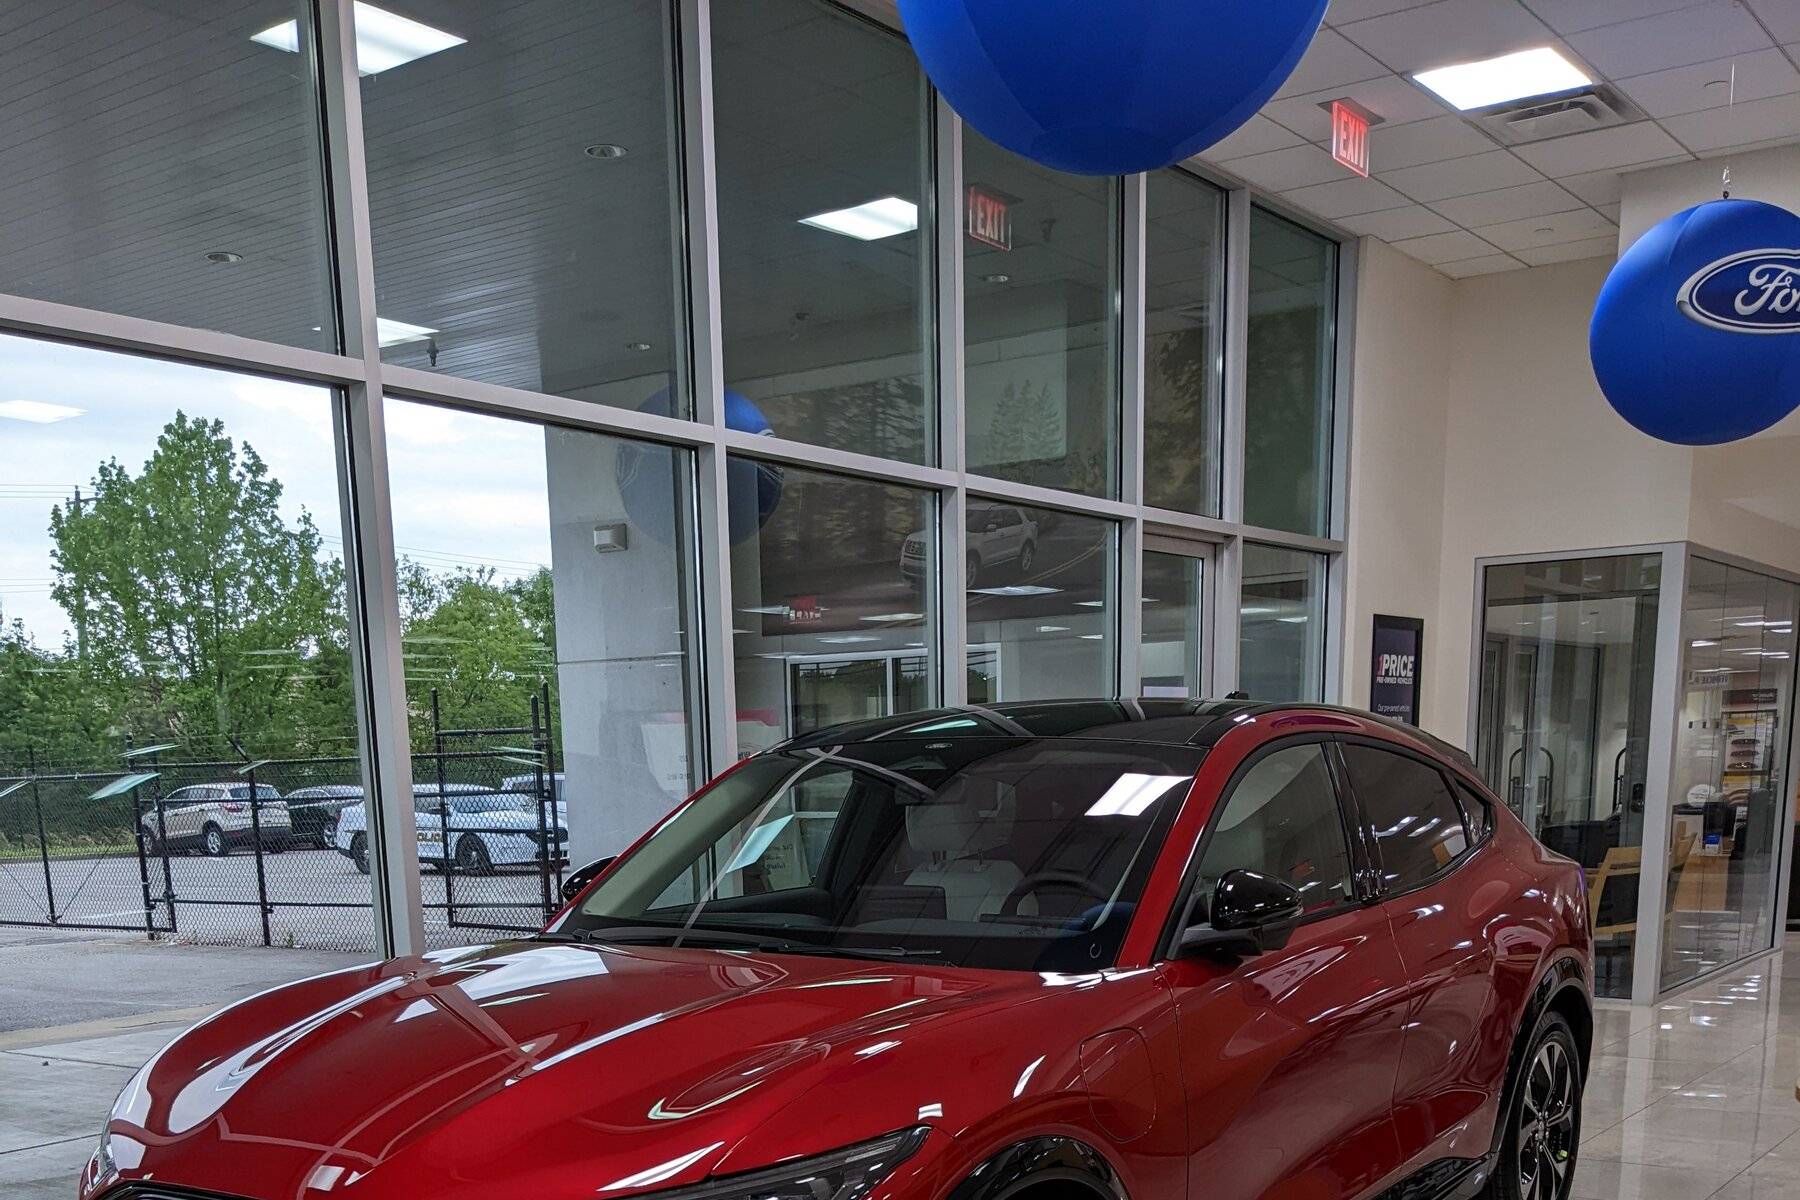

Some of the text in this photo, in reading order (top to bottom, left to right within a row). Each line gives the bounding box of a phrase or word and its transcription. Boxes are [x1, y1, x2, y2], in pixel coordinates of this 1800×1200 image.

[1340, 109, 1367, 169] EXIT
[977, 193, 1006, 243] EXIT
[1734, 264, 1800, 315] Fo
